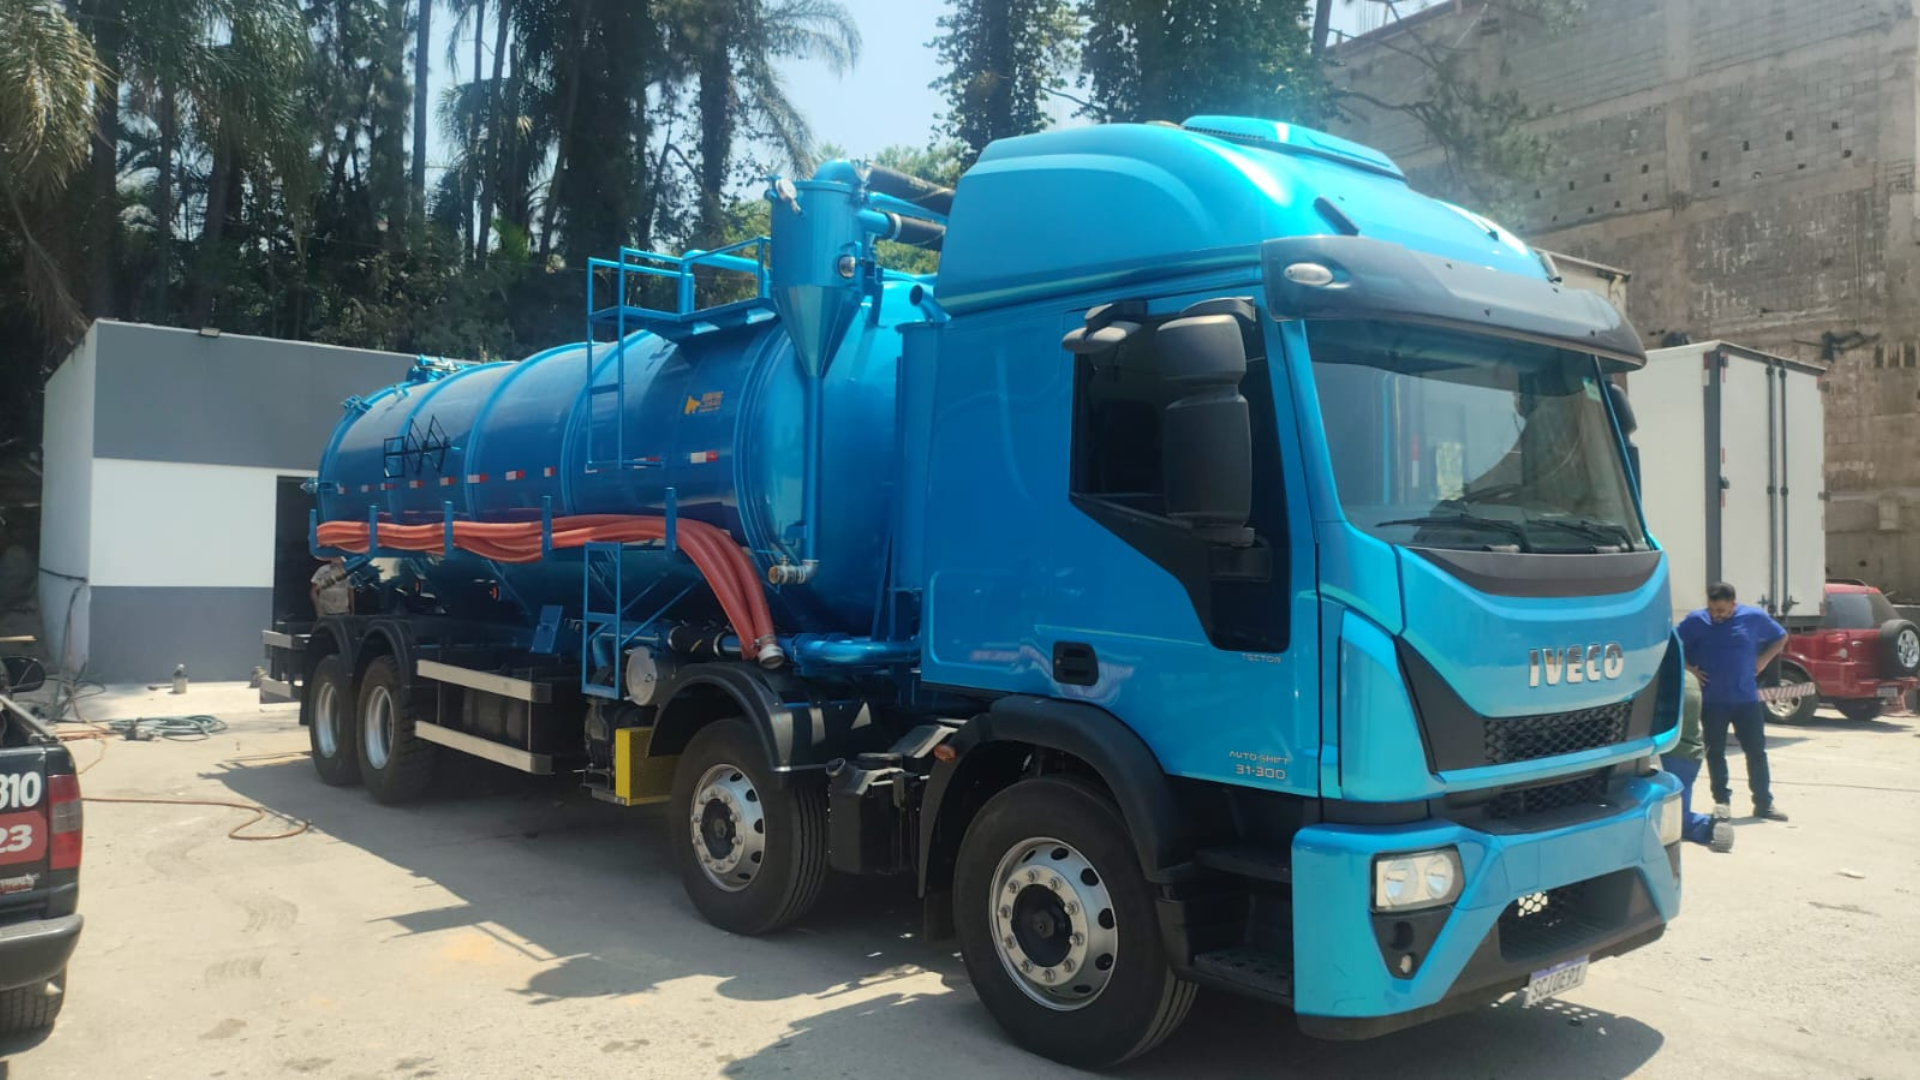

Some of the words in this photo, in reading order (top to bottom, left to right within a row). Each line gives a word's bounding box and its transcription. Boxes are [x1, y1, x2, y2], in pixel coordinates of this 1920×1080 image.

[1241, 653, 1281, 663] TECTOR
[1529, 643, 1624, 688] IVECO
[1235, 764, 1286, 780] 31-300
